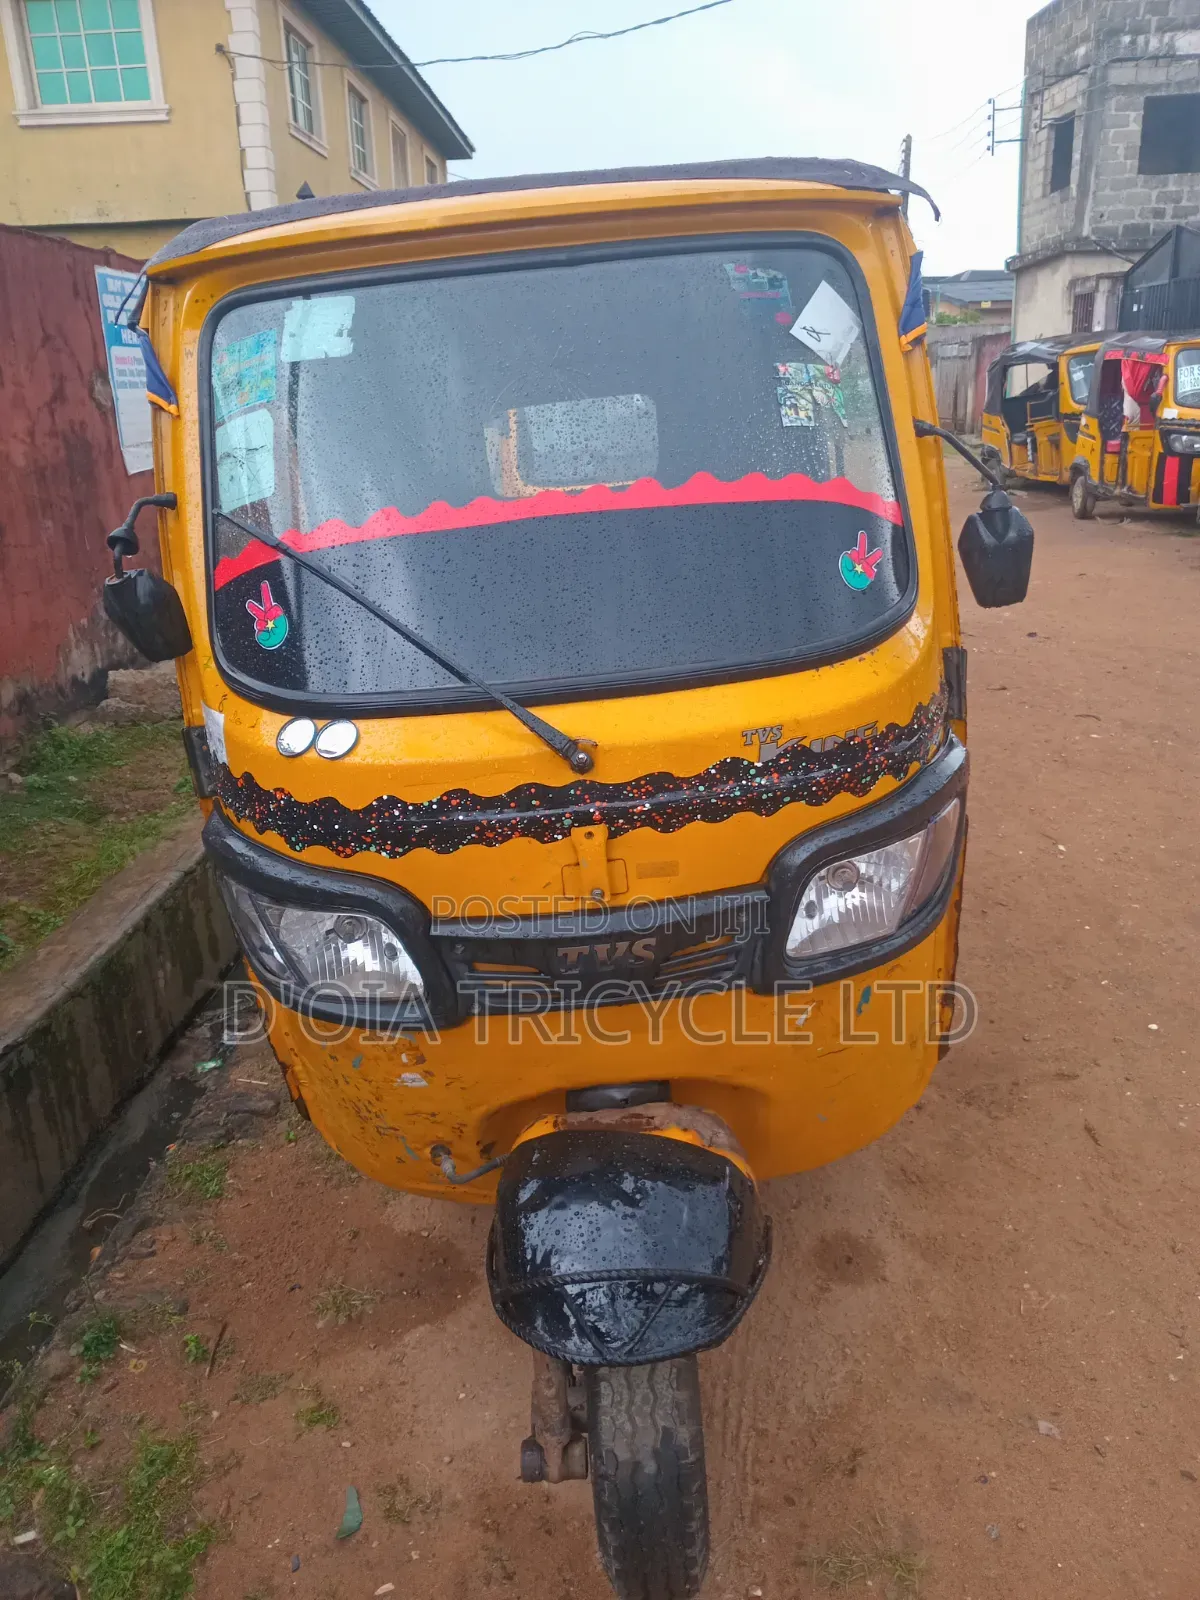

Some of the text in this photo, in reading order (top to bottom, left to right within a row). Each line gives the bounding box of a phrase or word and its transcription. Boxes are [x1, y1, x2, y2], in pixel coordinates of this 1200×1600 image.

[1179, 366, 1195, 380] FOR
[742, 725, 782, 746] TVS
[556, 937, 657, 972] TVS
